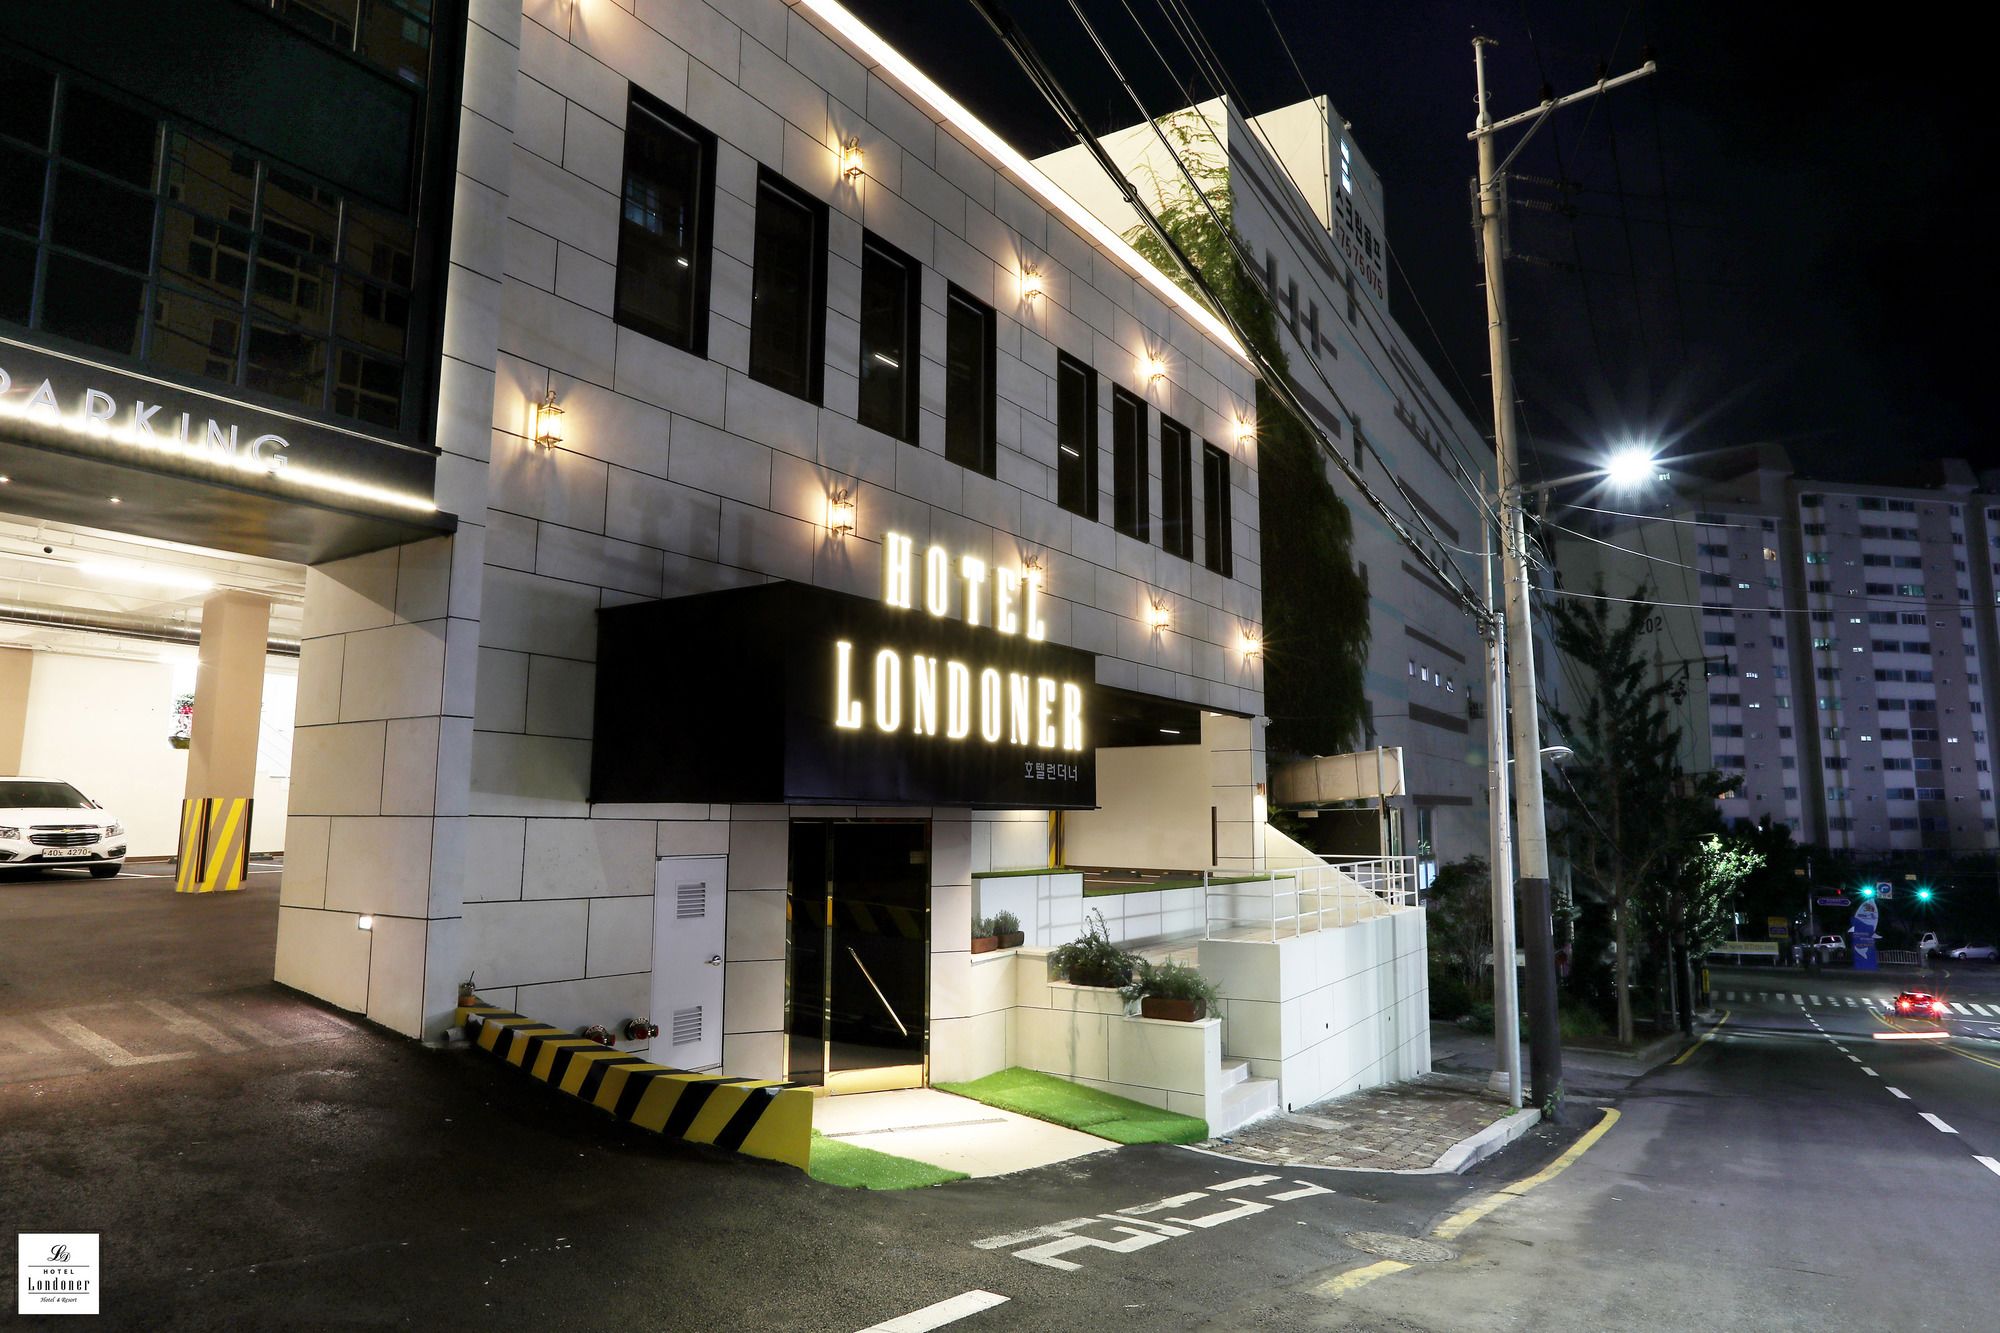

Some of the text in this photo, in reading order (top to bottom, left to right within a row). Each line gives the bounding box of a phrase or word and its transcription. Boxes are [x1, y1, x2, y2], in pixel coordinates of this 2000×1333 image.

[1335, 185, 1382, 271] 스크린골프
[883, 531, 1046, 641] HOTEL
[835, 641, 1084, 751] LONDONER
[1024, 760, 1078, 782] 호텔런더너
